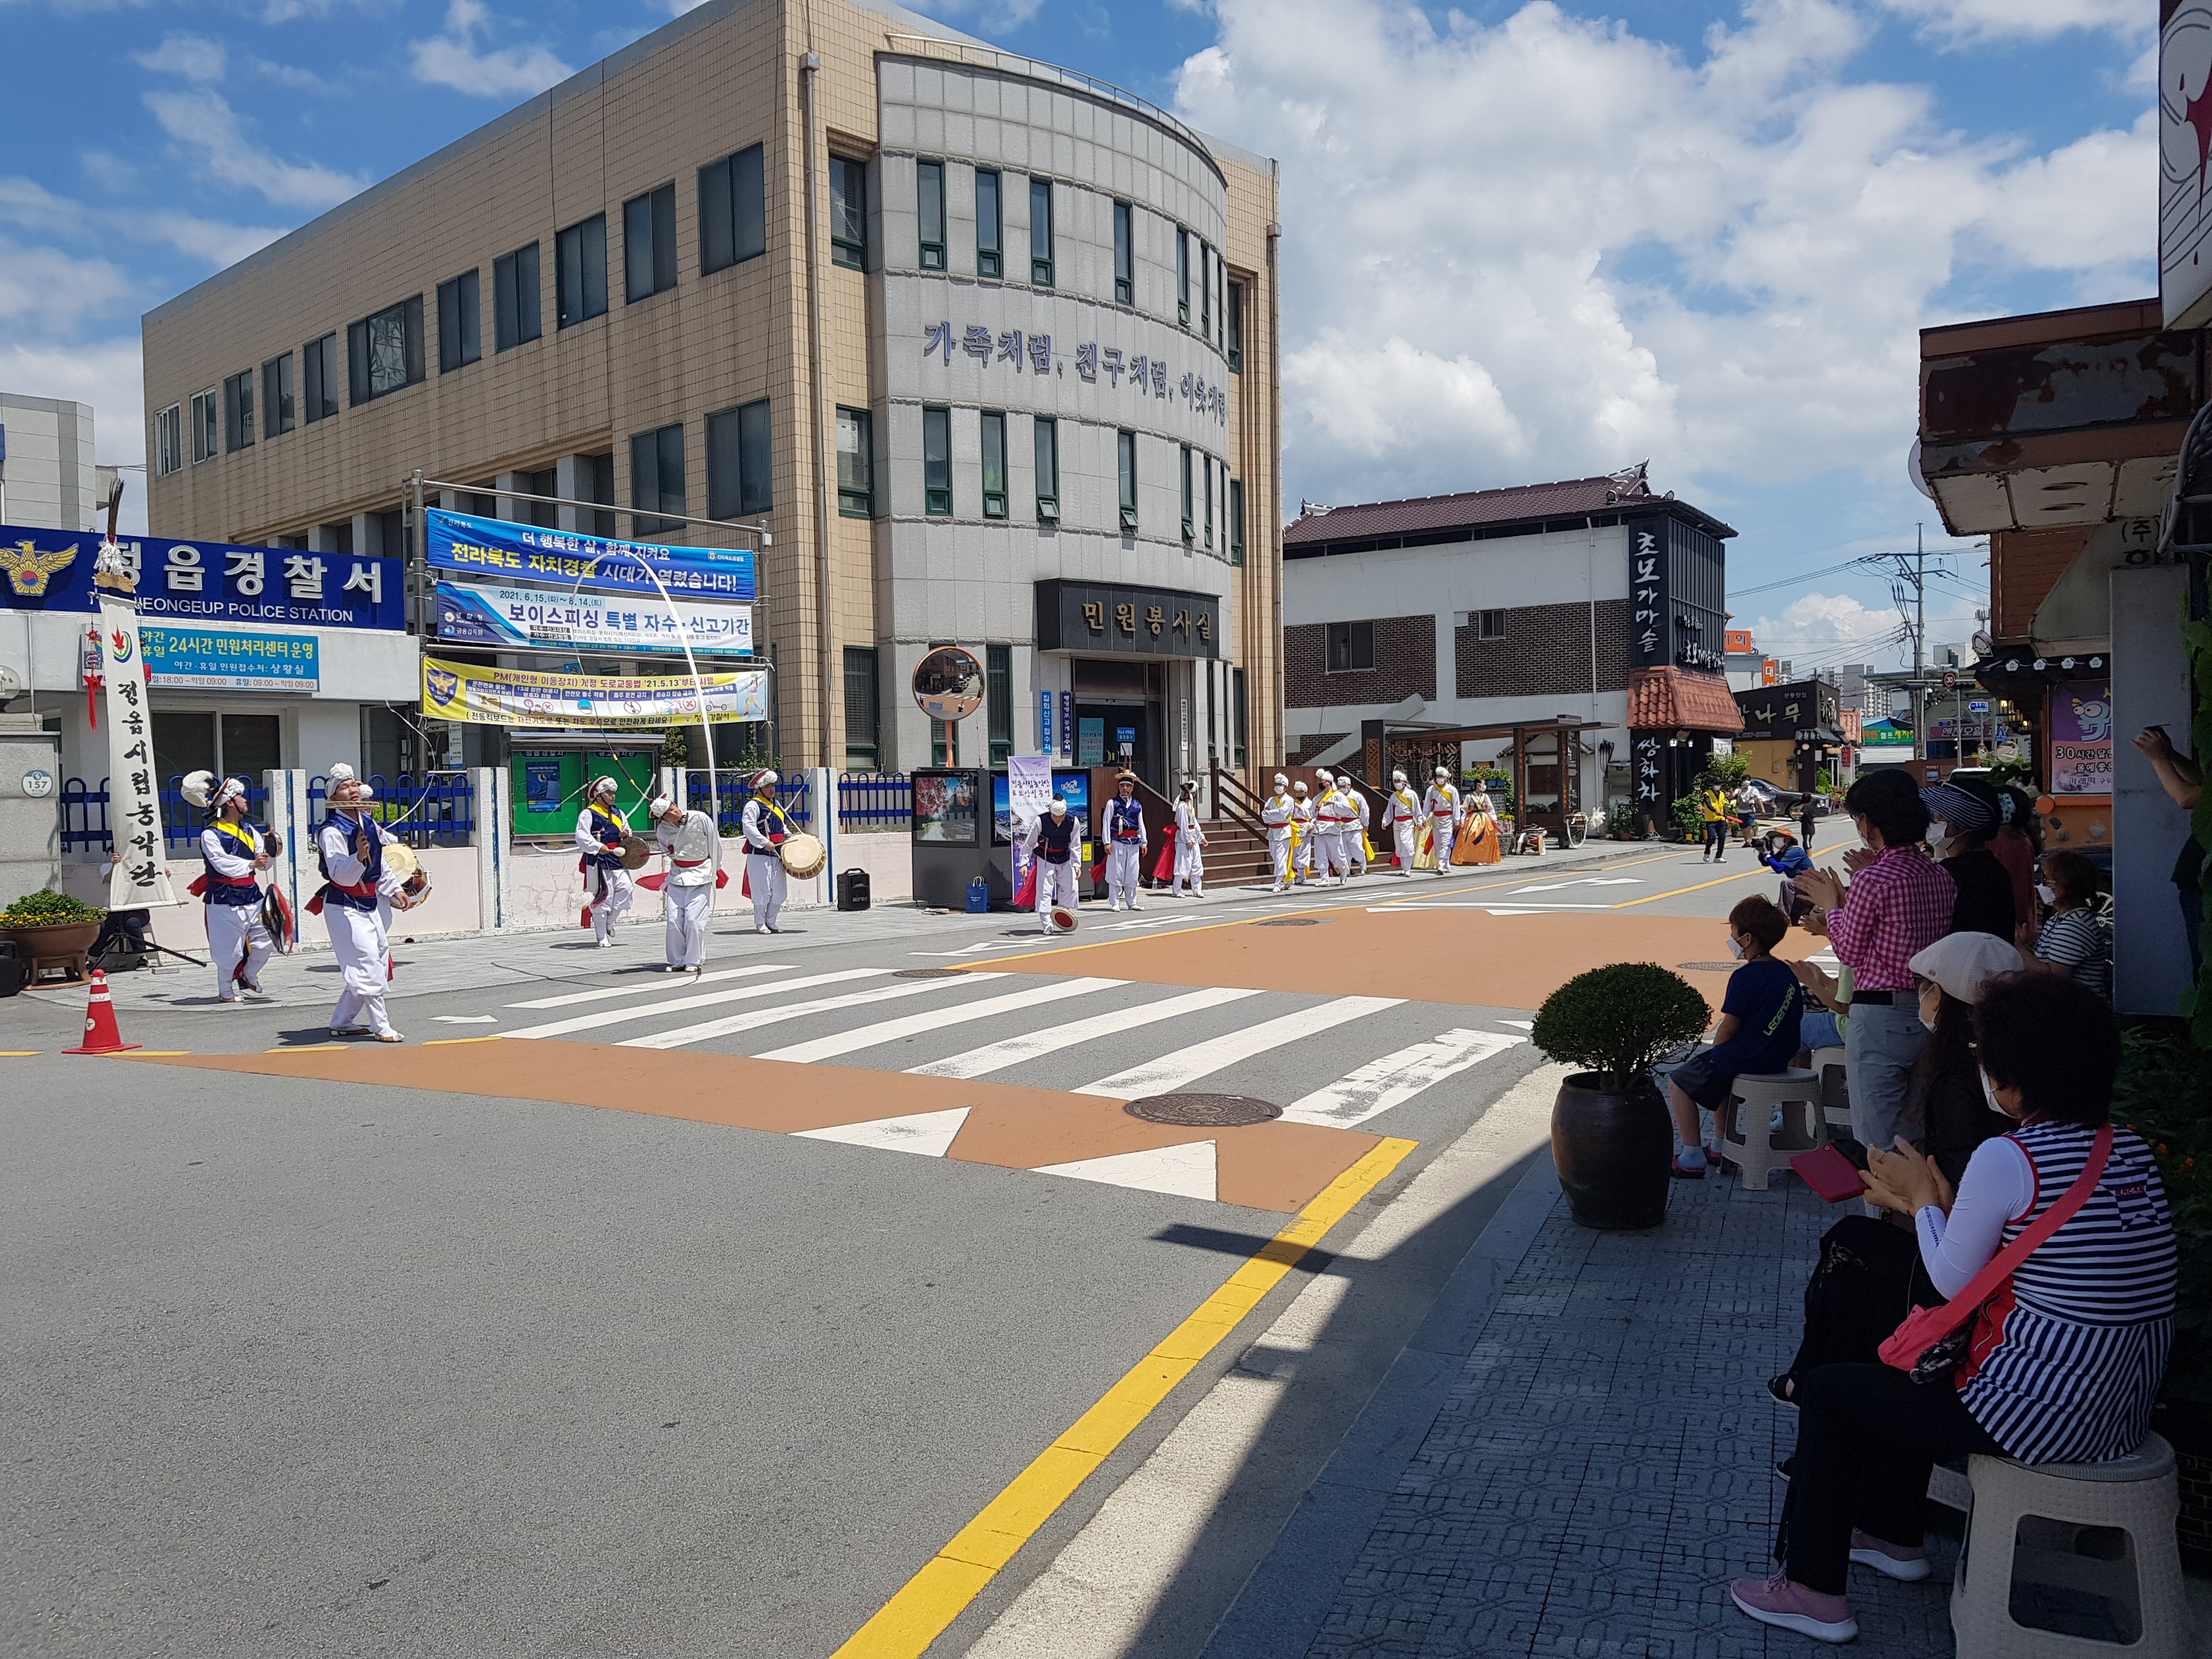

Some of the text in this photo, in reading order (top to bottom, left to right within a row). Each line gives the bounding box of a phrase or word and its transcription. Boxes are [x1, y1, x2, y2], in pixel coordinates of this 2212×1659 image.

[924, 320, 1225, 423] 가족처럼, 친구처럼, 이웃처럼
[522, 531, 671, 561] 더 행복한 삶, 함께 지켜요
[451, 542, 737, 592] 전라북도 자치경찰 시대가 열렸습니다!
[1634, 531, 1661, 653] 초모가마솥
[228, 602, 284, 618] POLICE
[289, 607, 353, 622] STATION
[508, 604, 598, 629] 보이스피싱
[605, 611, 638, 631] 특별
[1081, 601, 1211, 640] 민원봉사실
[141, 630, 313, 659] 야간 24시간 민원처리센터 운영
[141, 645, 165, 658] 휴일
[220, 662, 267, 674] 민원접수처:
[270, 663, 304, 675] 상황실
[493, 671, 538, 684] PM(개인형
[541, 674, 578, 687] 이동장치)
[600, 679, 641, 688] 도로교통법
[700, 677, 714, 686] 시행
[151, 675, 162, 684] 일:
[163, 675, 184, 684] 18:00
[207, 677, 227, 686] 09:00
[235, 677, 252, 687] 휴일:
[253, 678, 273, 687] 09:00
[295, 680, 314, 689] 09:00
[619, 717, 647, 726] 안전하게
[2055, 747, 2095, 759] 30시간
[1637, 737, 1661, 803] 쌍화차
[2076, 763, 2095, 773] 몸에
[28, 780, 48, 789] 157
[118, 680, 163, 887] 정읍시립농악단
